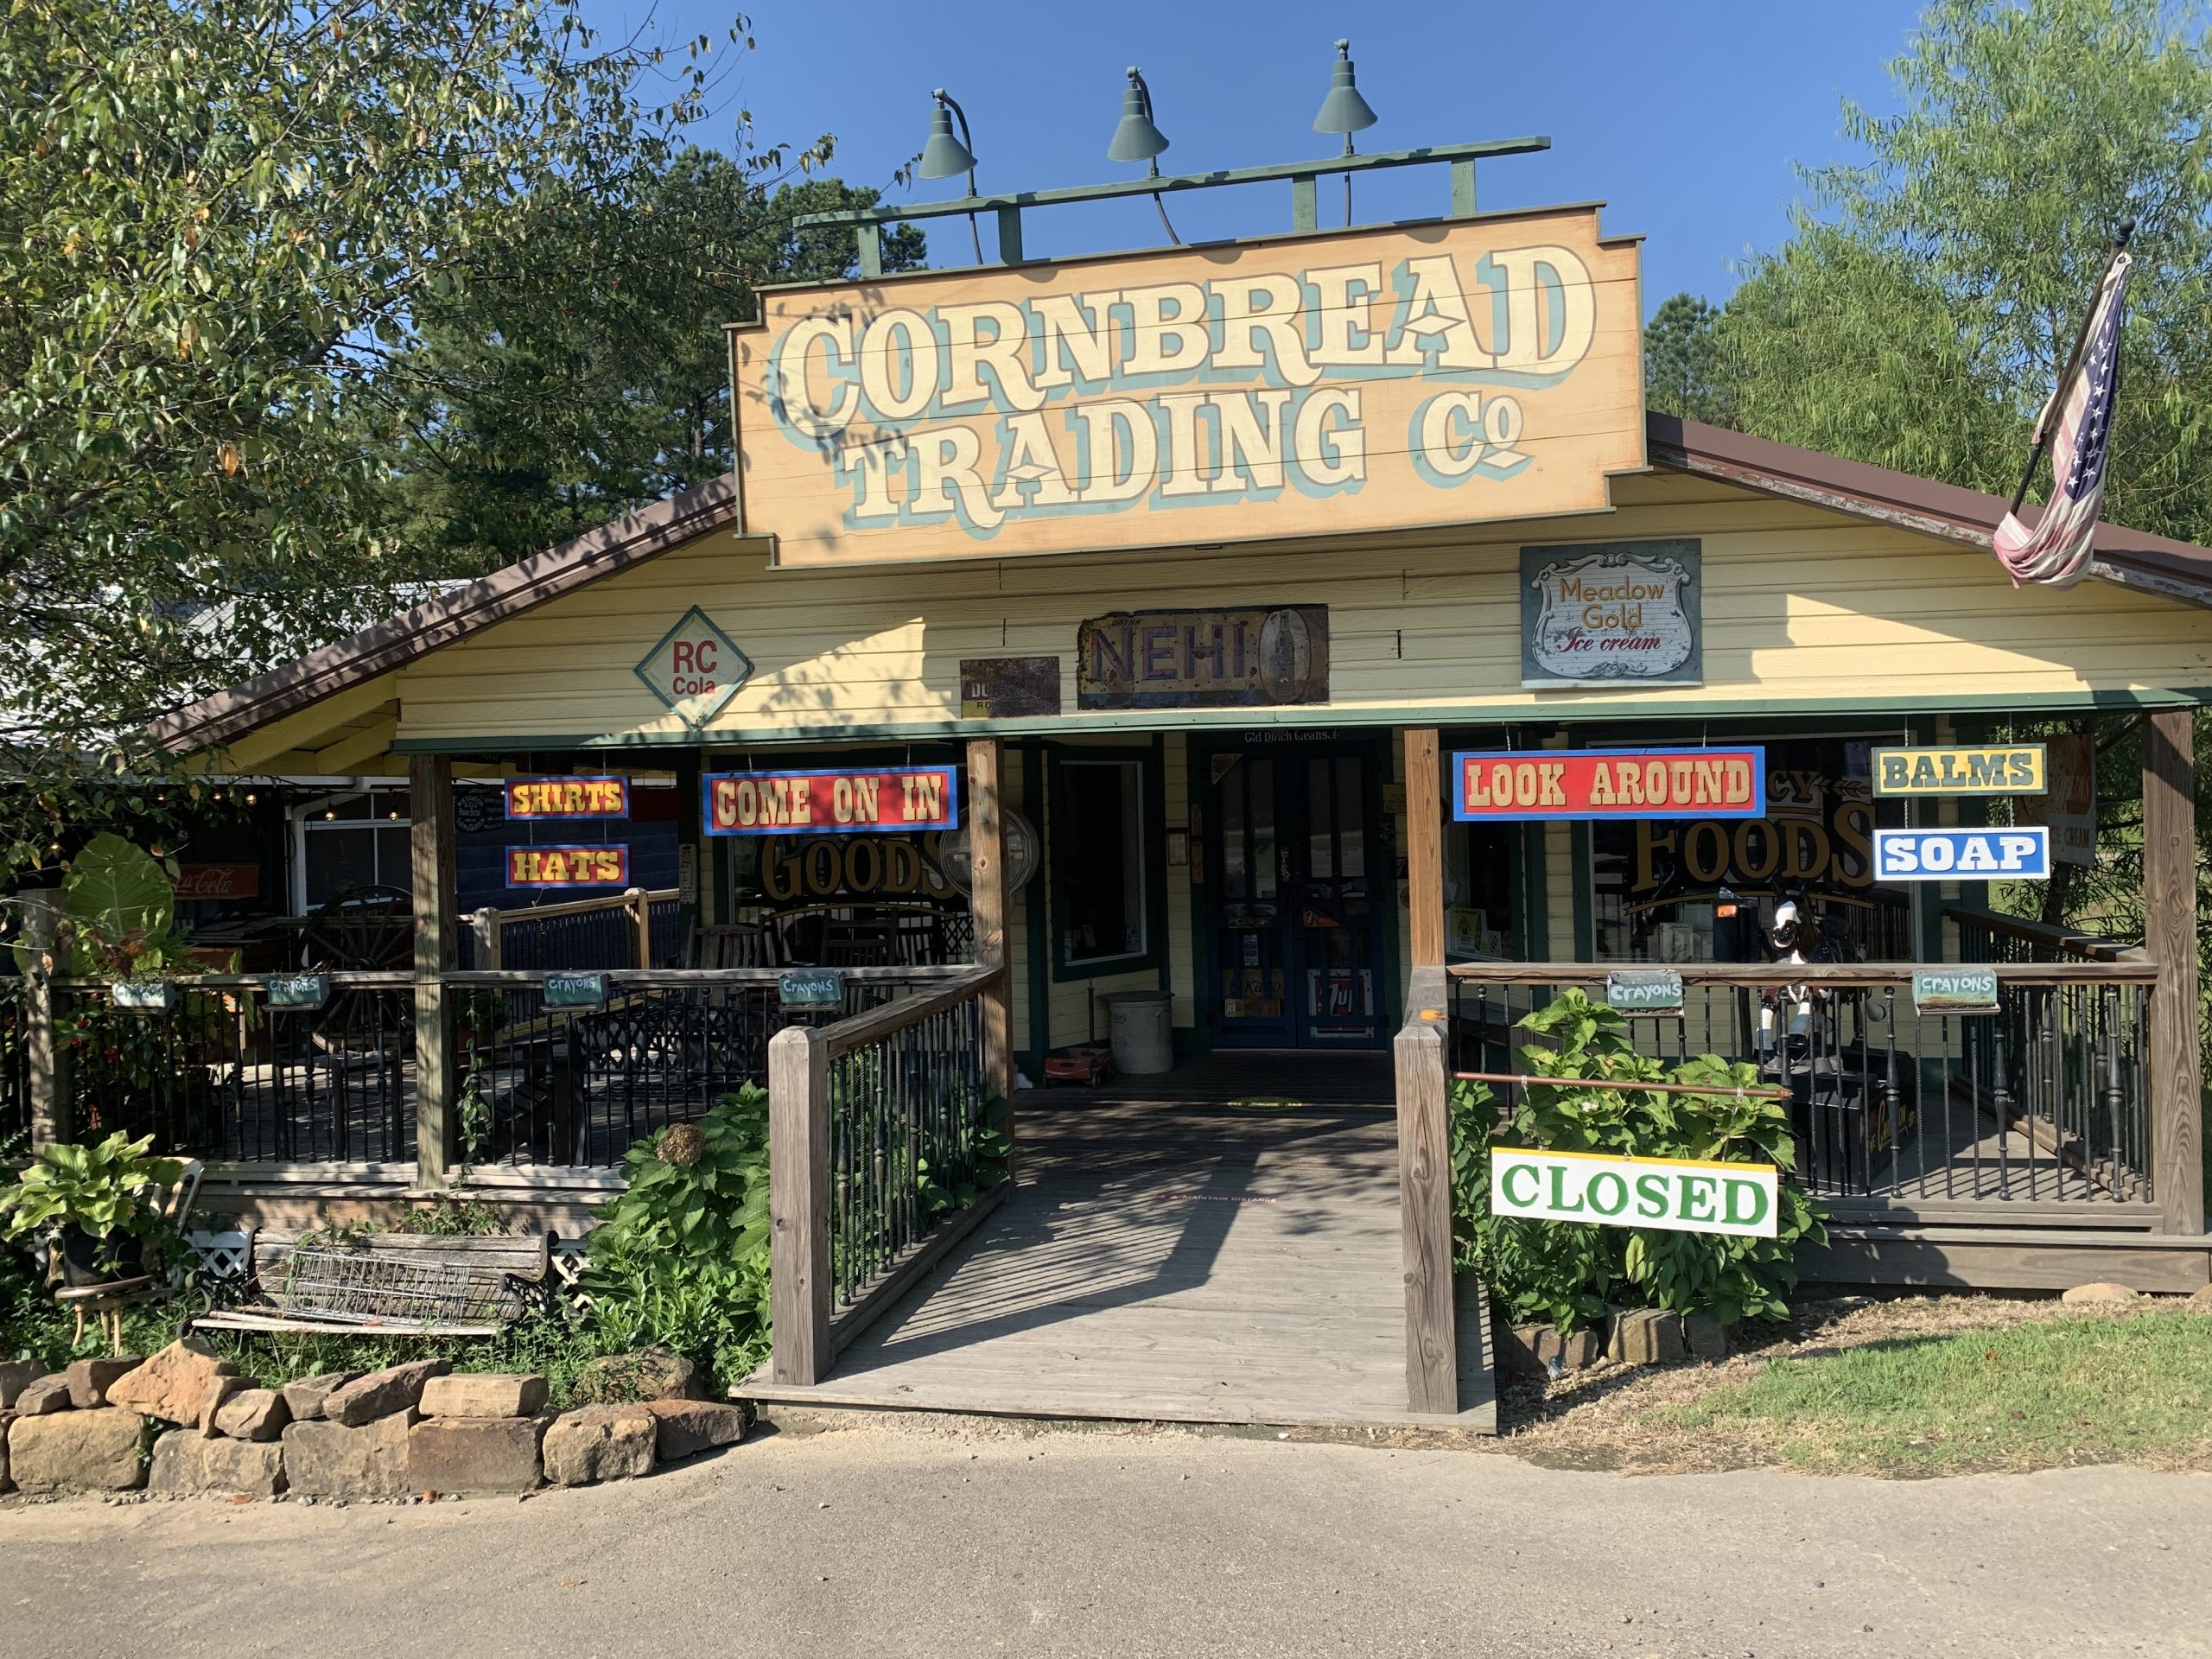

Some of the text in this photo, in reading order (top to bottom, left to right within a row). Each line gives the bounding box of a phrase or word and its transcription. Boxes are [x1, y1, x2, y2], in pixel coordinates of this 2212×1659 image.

[772, 245, 1597, 440] CORNBREAD
[842, 387, 1367, 530] TRADING
[1559, 575, 1666, 603] Meadow
[1582, 602, 1644, 629] Gold
[672, 639, 718, 674] RC
[1090, 624, 1245, 682] NEHI
[1556, 627, 1662, 652] Ice cream
[672, 677, 716, 696] Cola
[1467, 763, 1567, 807] LOOK
[1589, 760, 1751, 806] AROUND
[1883, 753, 2034, 788] BALMS
[513, 783, 622, 813] SHIRTS
[717, 775, 943, 826] COME ON IN
[1631, 801, 1876, 887] FOODS
[1885, 836, 2037, 872] SOAP
[513, 851, 620, 881] HATS
[761, 830, 959, 901] GOODS
[1501, 1163, 1770, 1226] CLOSED
